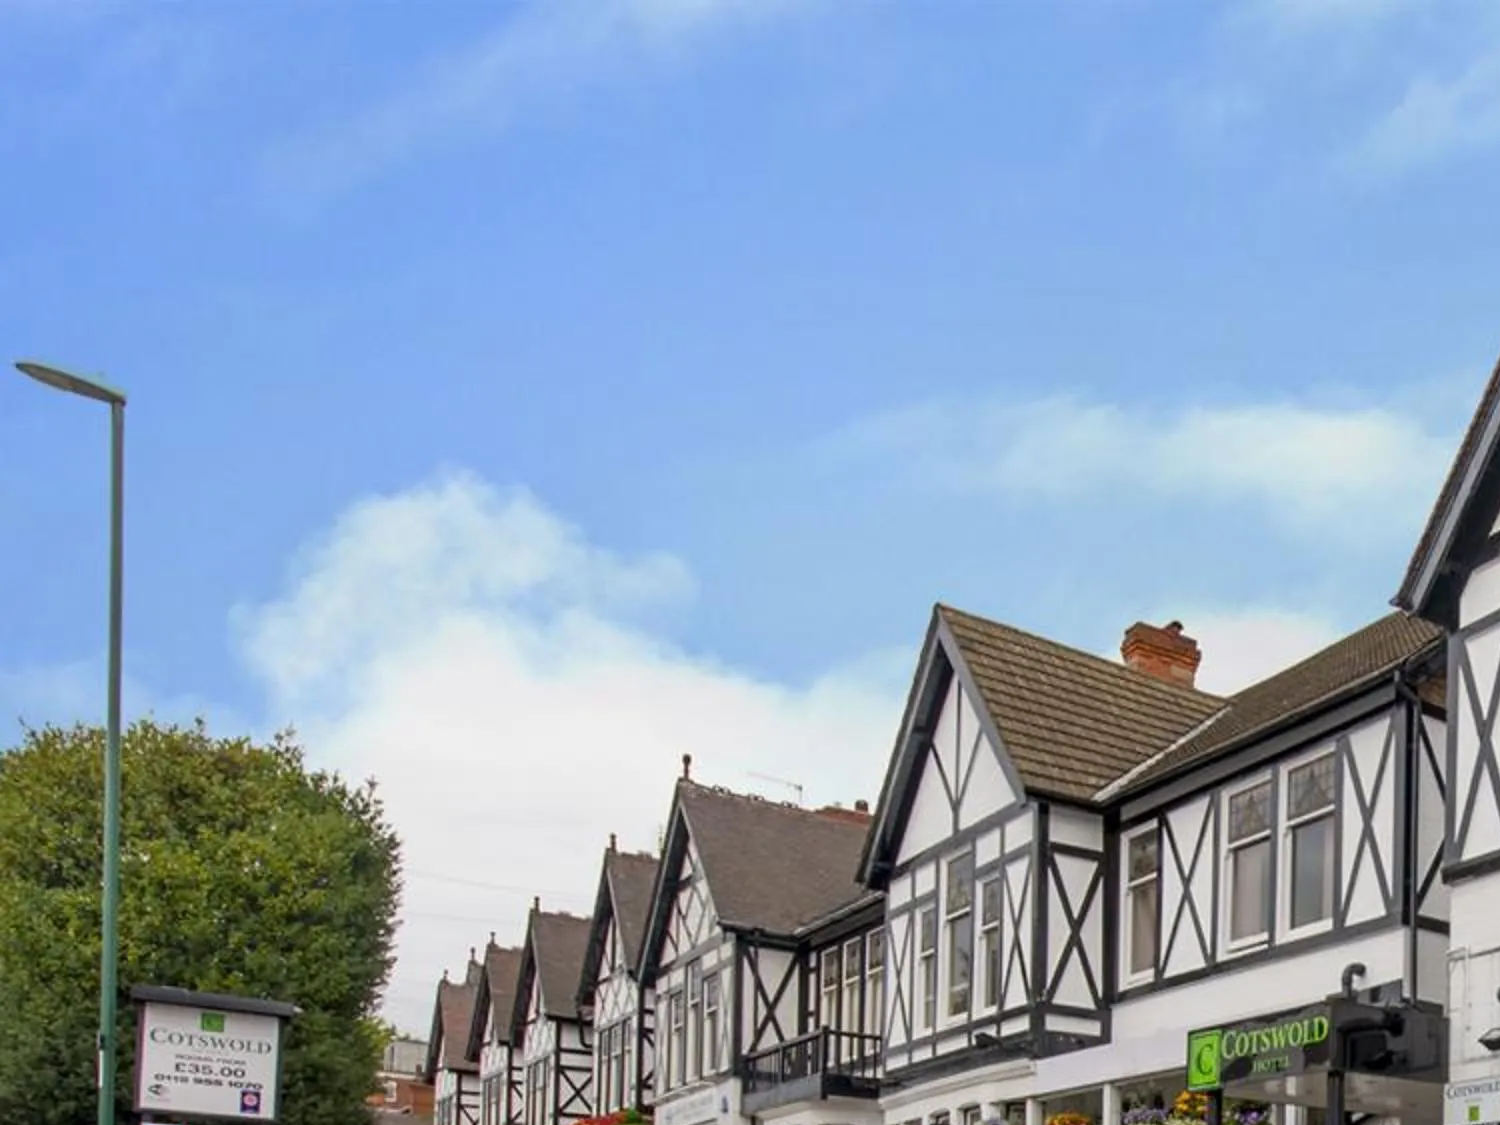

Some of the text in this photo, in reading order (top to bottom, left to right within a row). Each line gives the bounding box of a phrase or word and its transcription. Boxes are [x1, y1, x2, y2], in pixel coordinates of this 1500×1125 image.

[150, 1027, 272, 1055] COTSWOLD
[1222, 1015, 1330, 1059] COTSWOLD
[174, 1062, 247, 1079] £35.00
[1197, 1044, 1214, 1075] C
